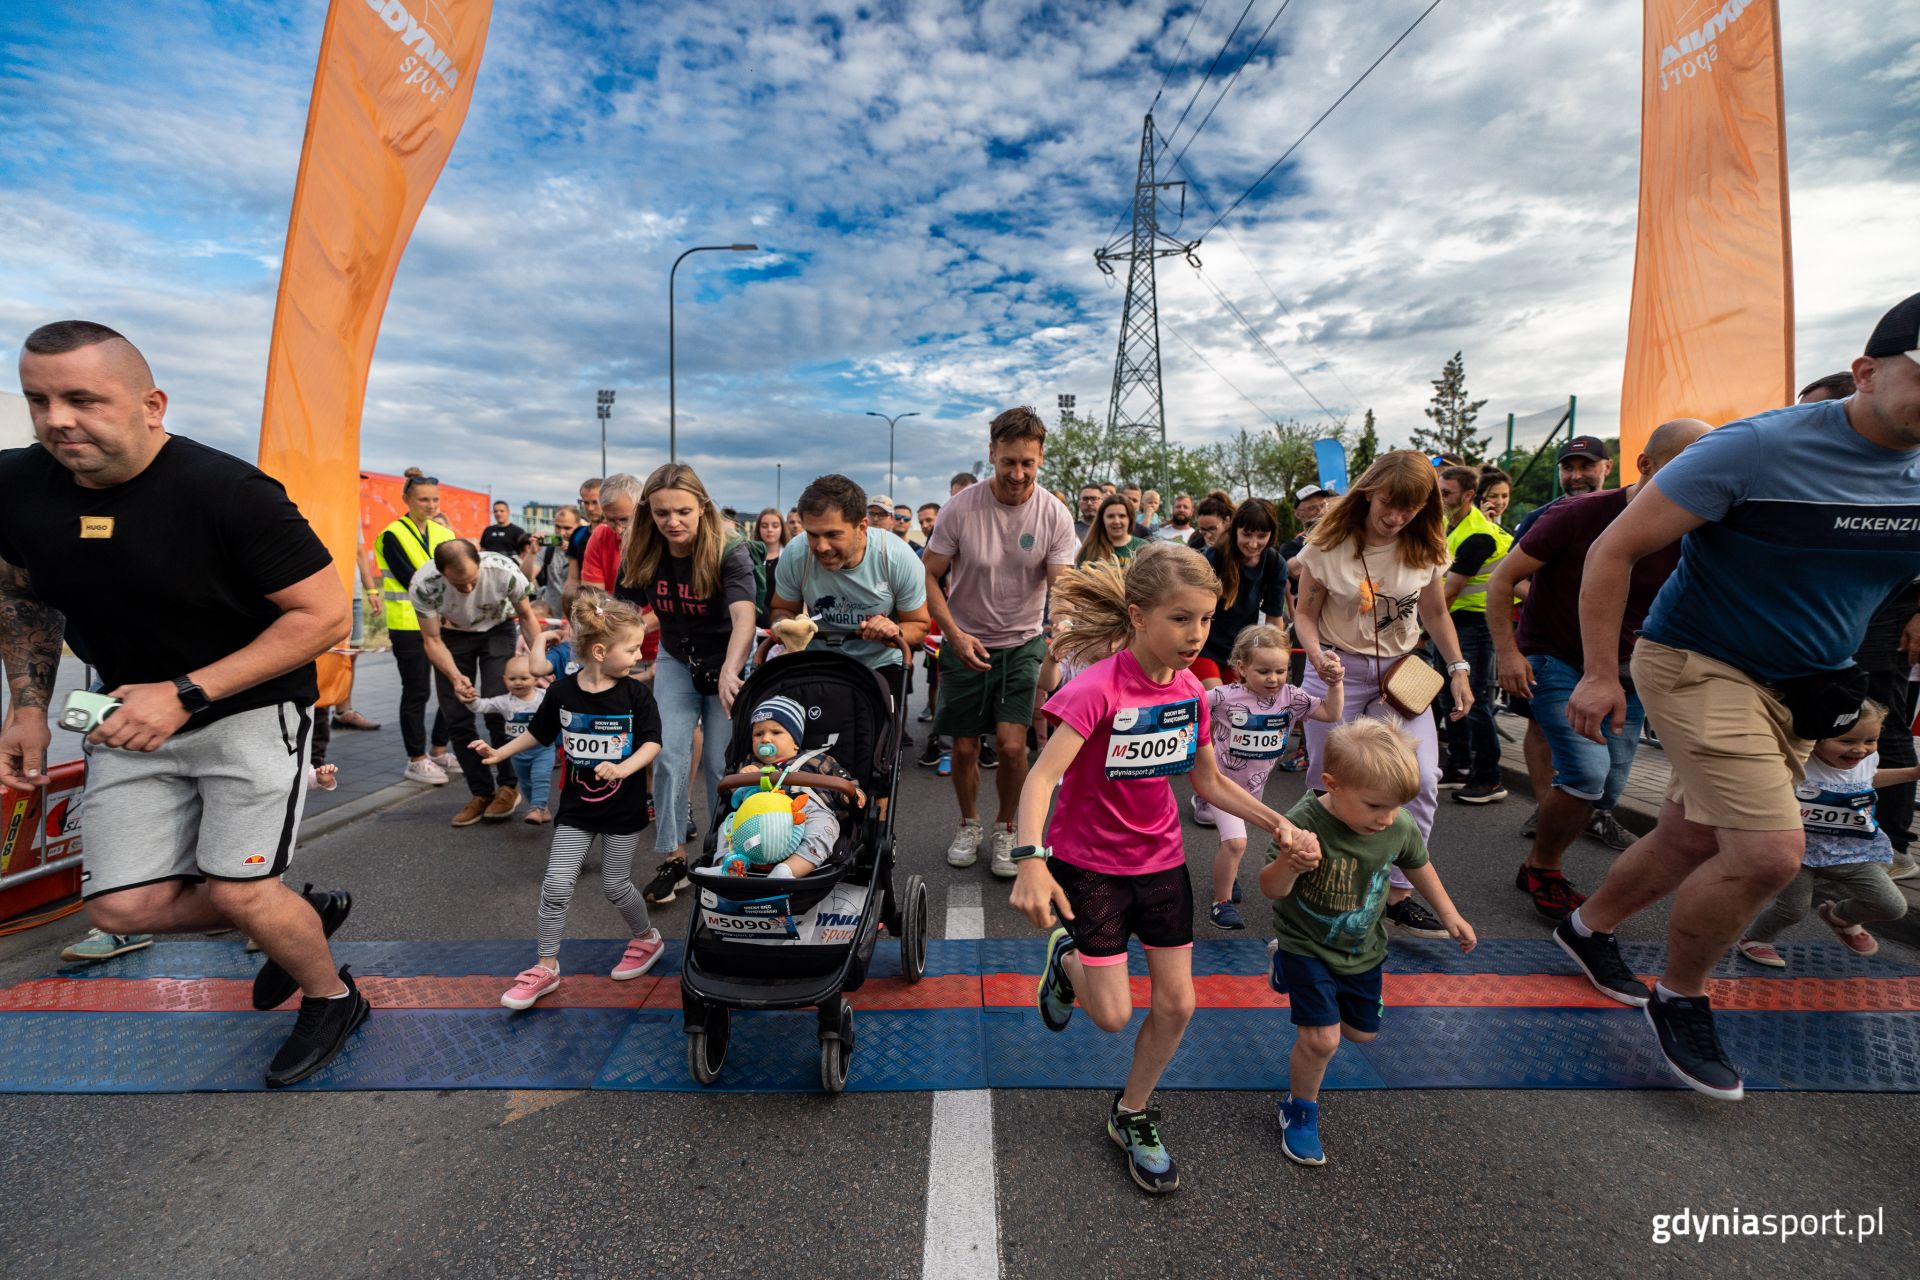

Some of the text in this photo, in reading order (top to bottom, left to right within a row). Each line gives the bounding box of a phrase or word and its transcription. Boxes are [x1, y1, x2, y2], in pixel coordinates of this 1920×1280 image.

[1834, 517, 1920, 531] MCKENZI
[657, 580, 704, 600] GRL
[1232, 734, 1278, 747] M5108
[1111, 736, 1178, 760] M5009
[1109, 768, 1155, 778] gdyniasport.pl
[1800, 808, 1867, 825] M5019
[708, 916, 771, 930] M5090
